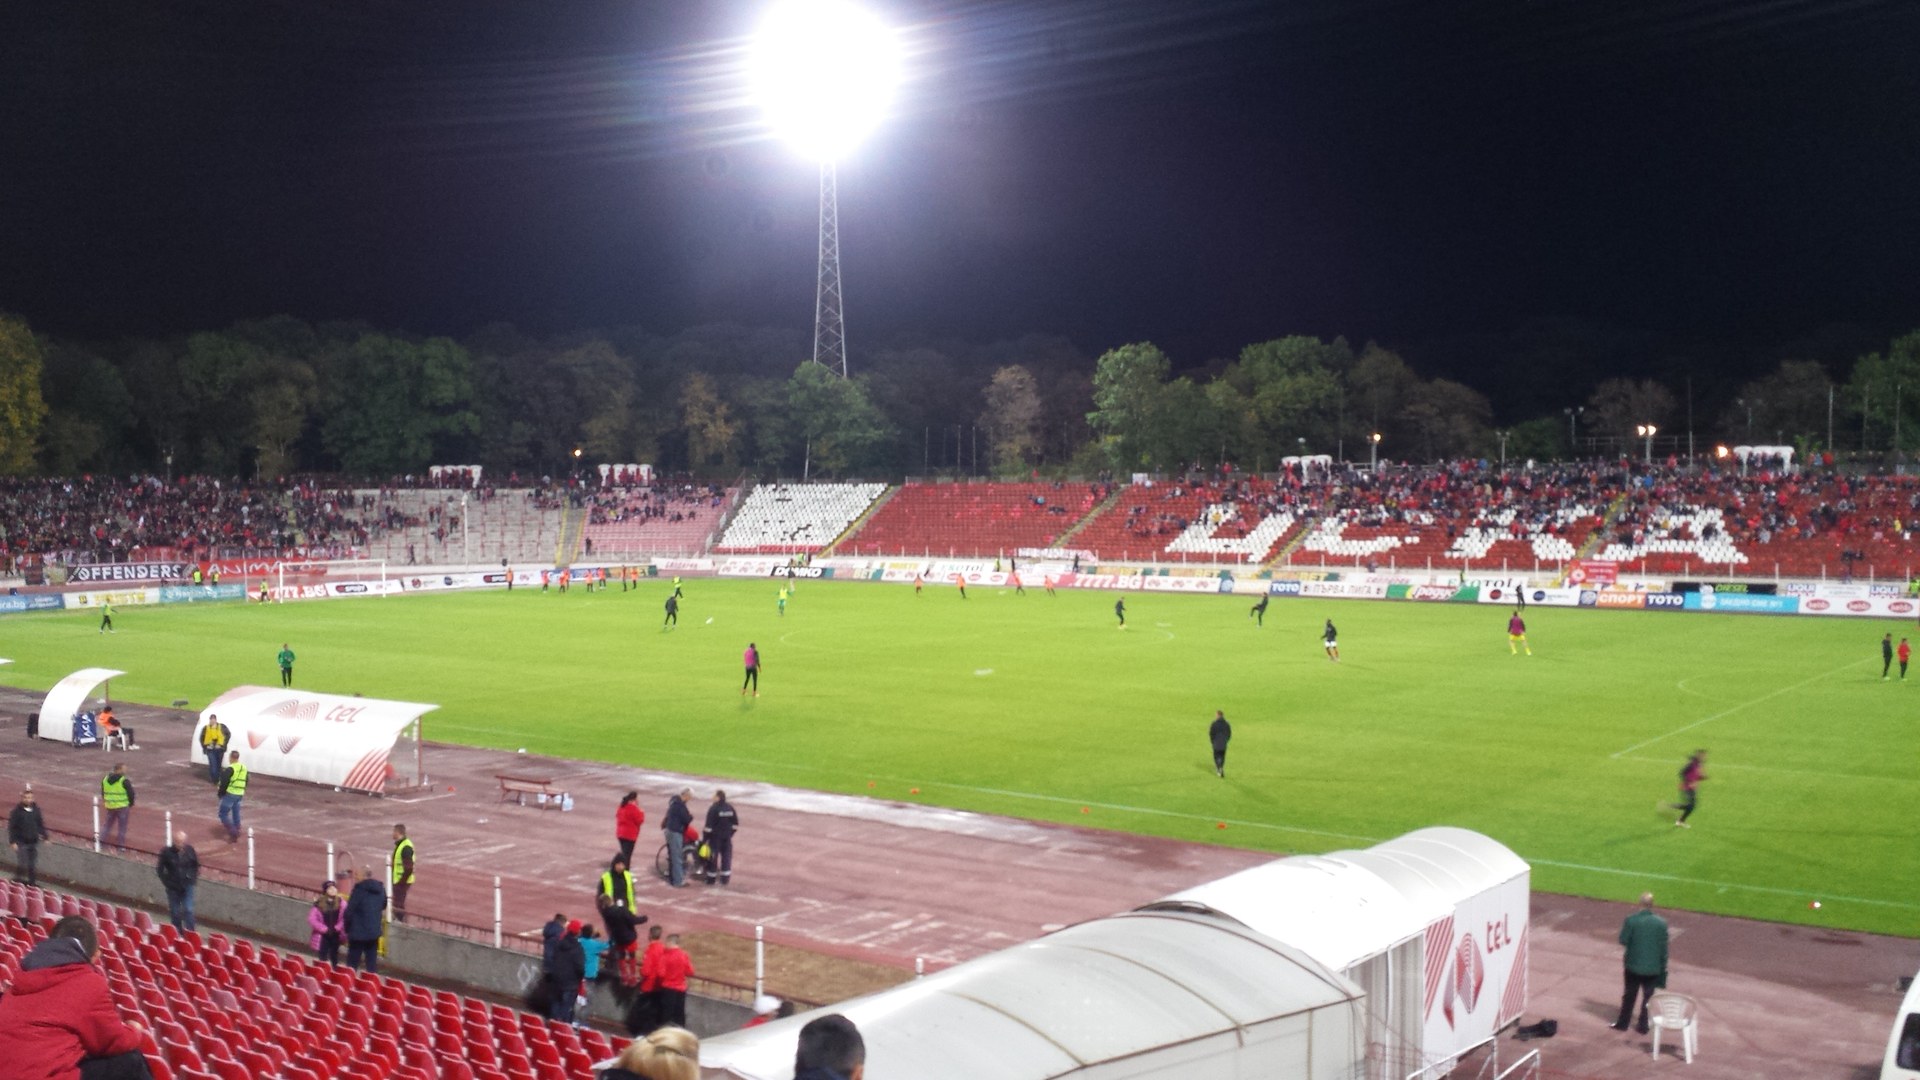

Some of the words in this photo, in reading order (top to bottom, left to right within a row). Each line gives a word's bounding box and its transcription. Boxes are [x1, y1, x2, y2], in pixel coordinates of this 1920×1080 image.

[78, 564, 182, 580] OFFENDERS
[324, 703, 368, 724] tel
[1485, 912, 1512, 955] tel
